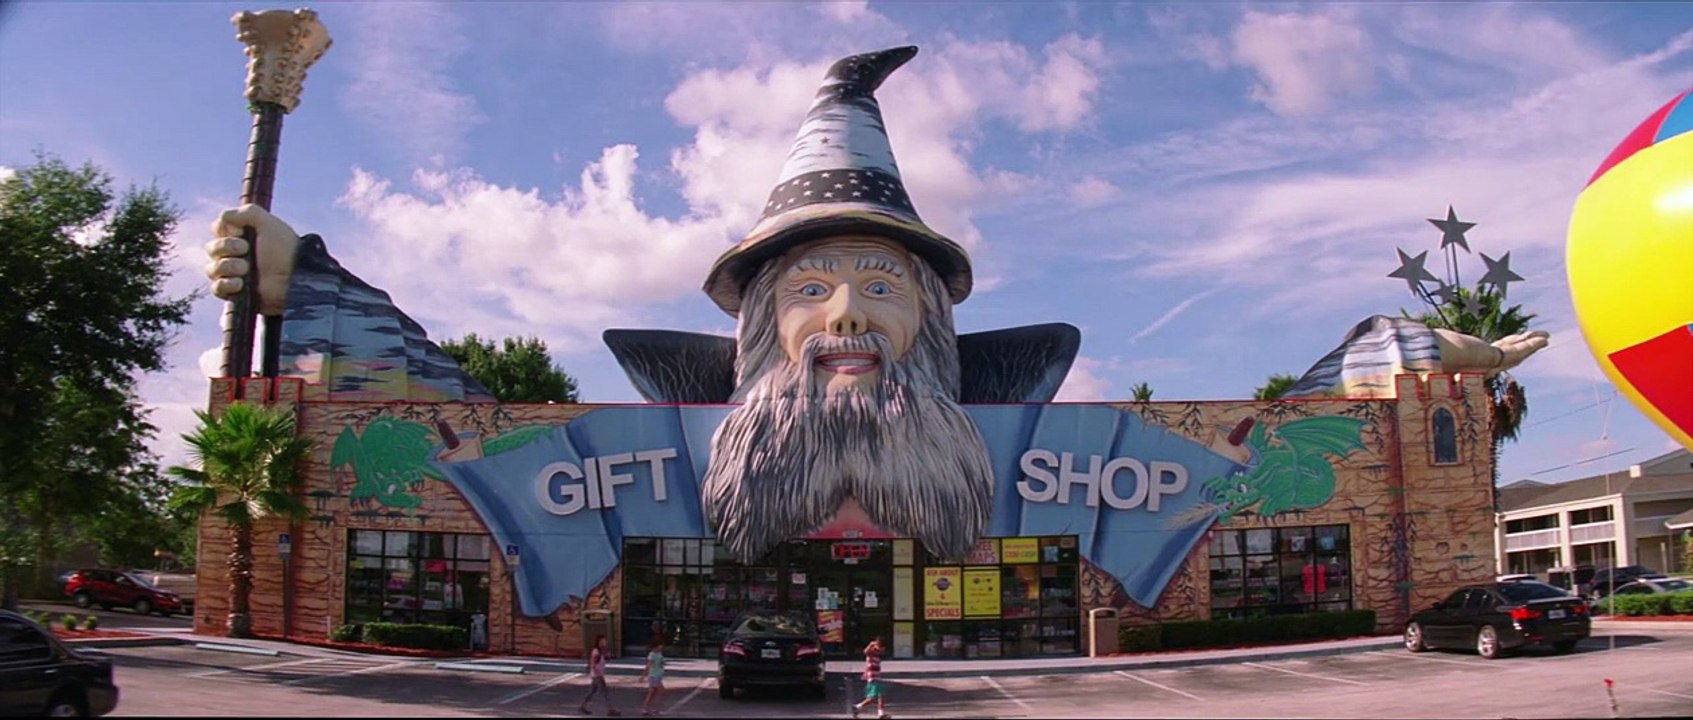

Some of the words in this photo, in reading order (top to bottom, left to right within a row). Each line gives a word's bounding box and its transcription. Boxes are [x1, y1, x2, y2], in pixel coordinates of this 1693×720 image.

[535, 448, 677, 515] GIFT
[1016, 449, 1189, 511] SHOP
[927, 607, 960, 617] SPECIALS
